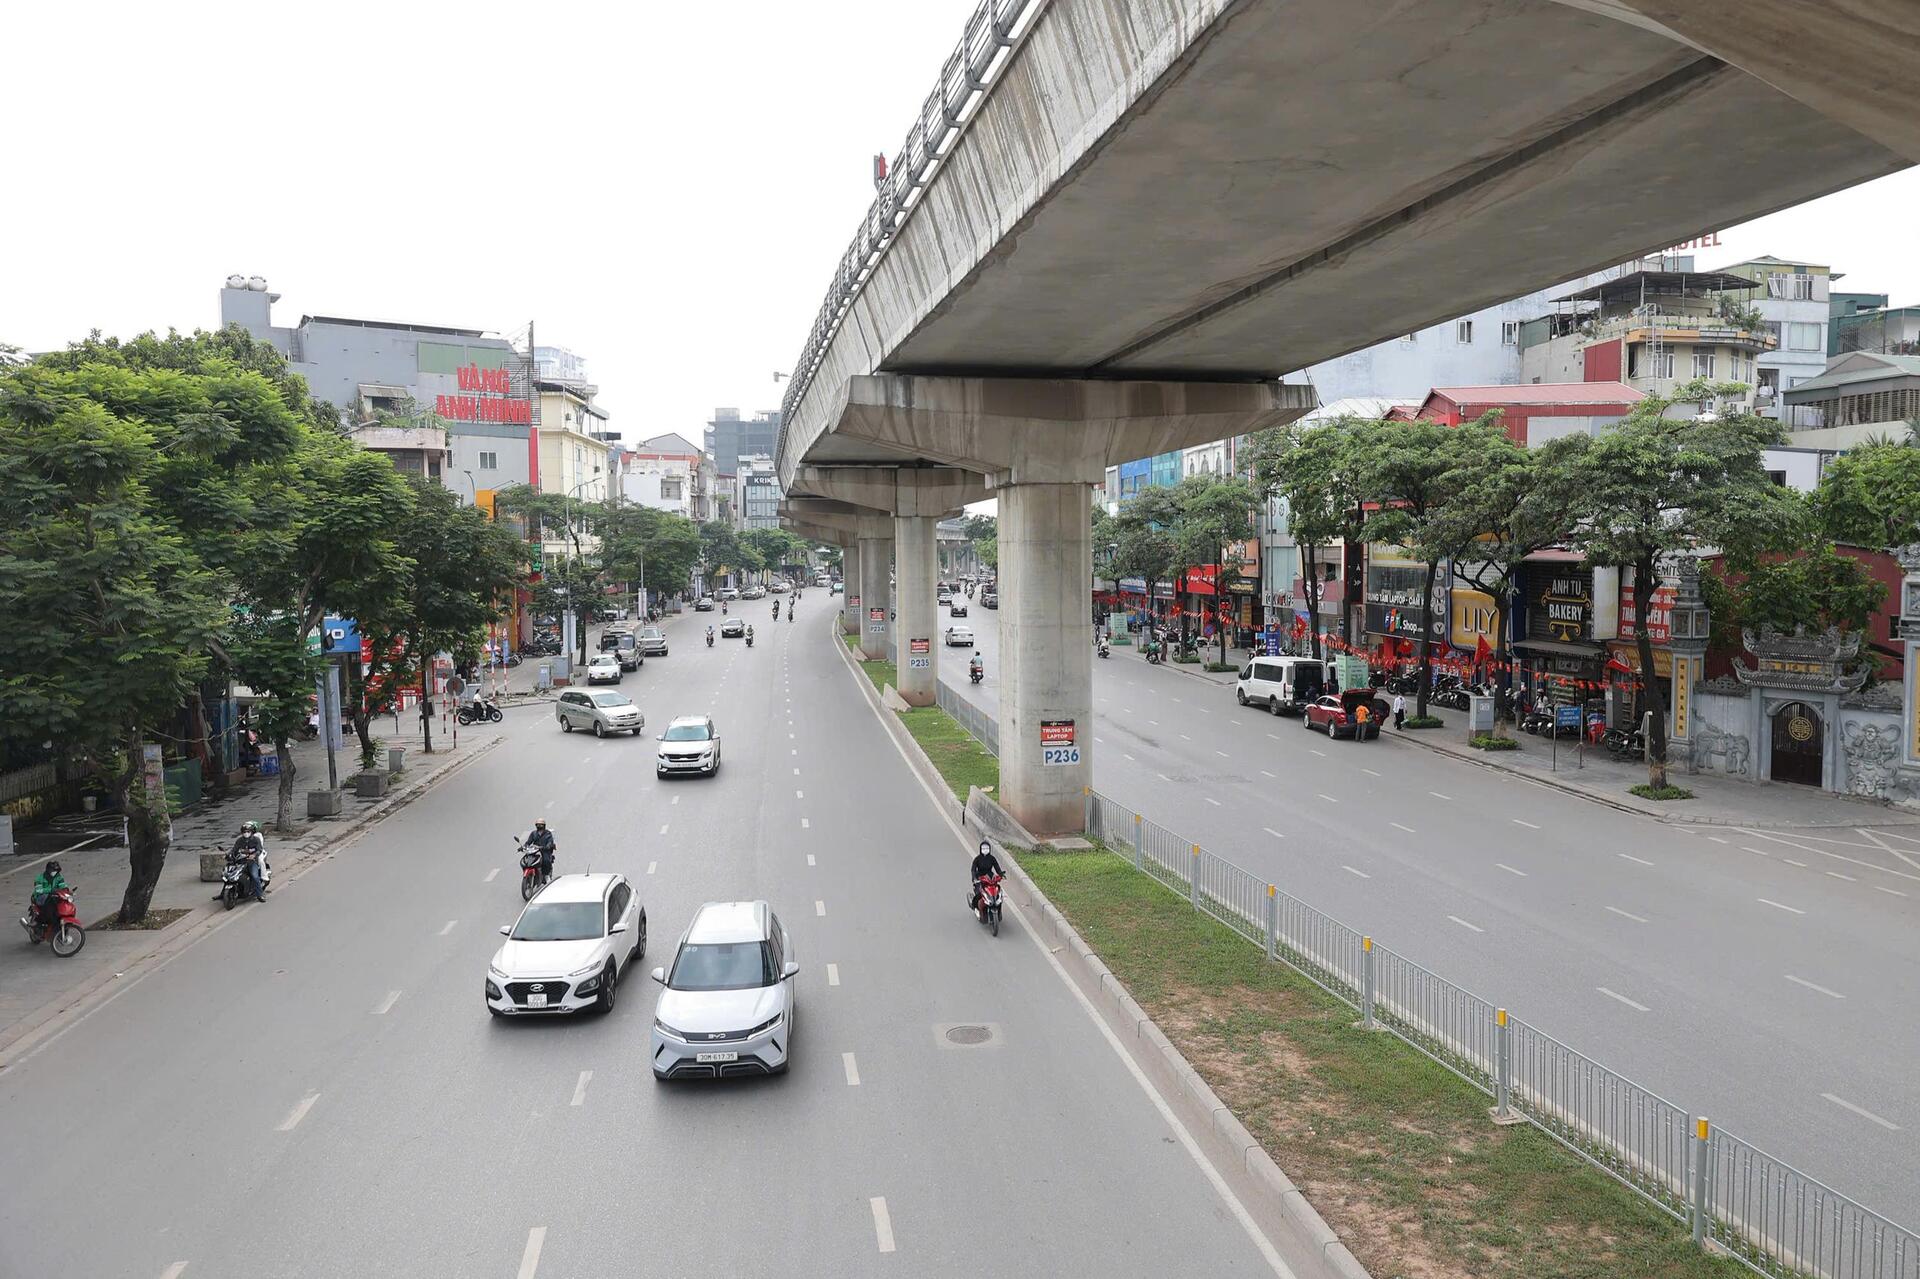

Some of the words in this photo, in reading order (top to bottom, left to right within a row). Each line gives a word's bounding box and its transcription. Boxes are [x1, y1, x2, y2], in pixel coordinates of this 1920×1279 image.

[1552, 579, 1569, 594] ANH
[1463, 607, 1497, 634] LILY
[1549, 604, 1583, 621] BAKERY
[1046, 749, 1079, 763] P236
